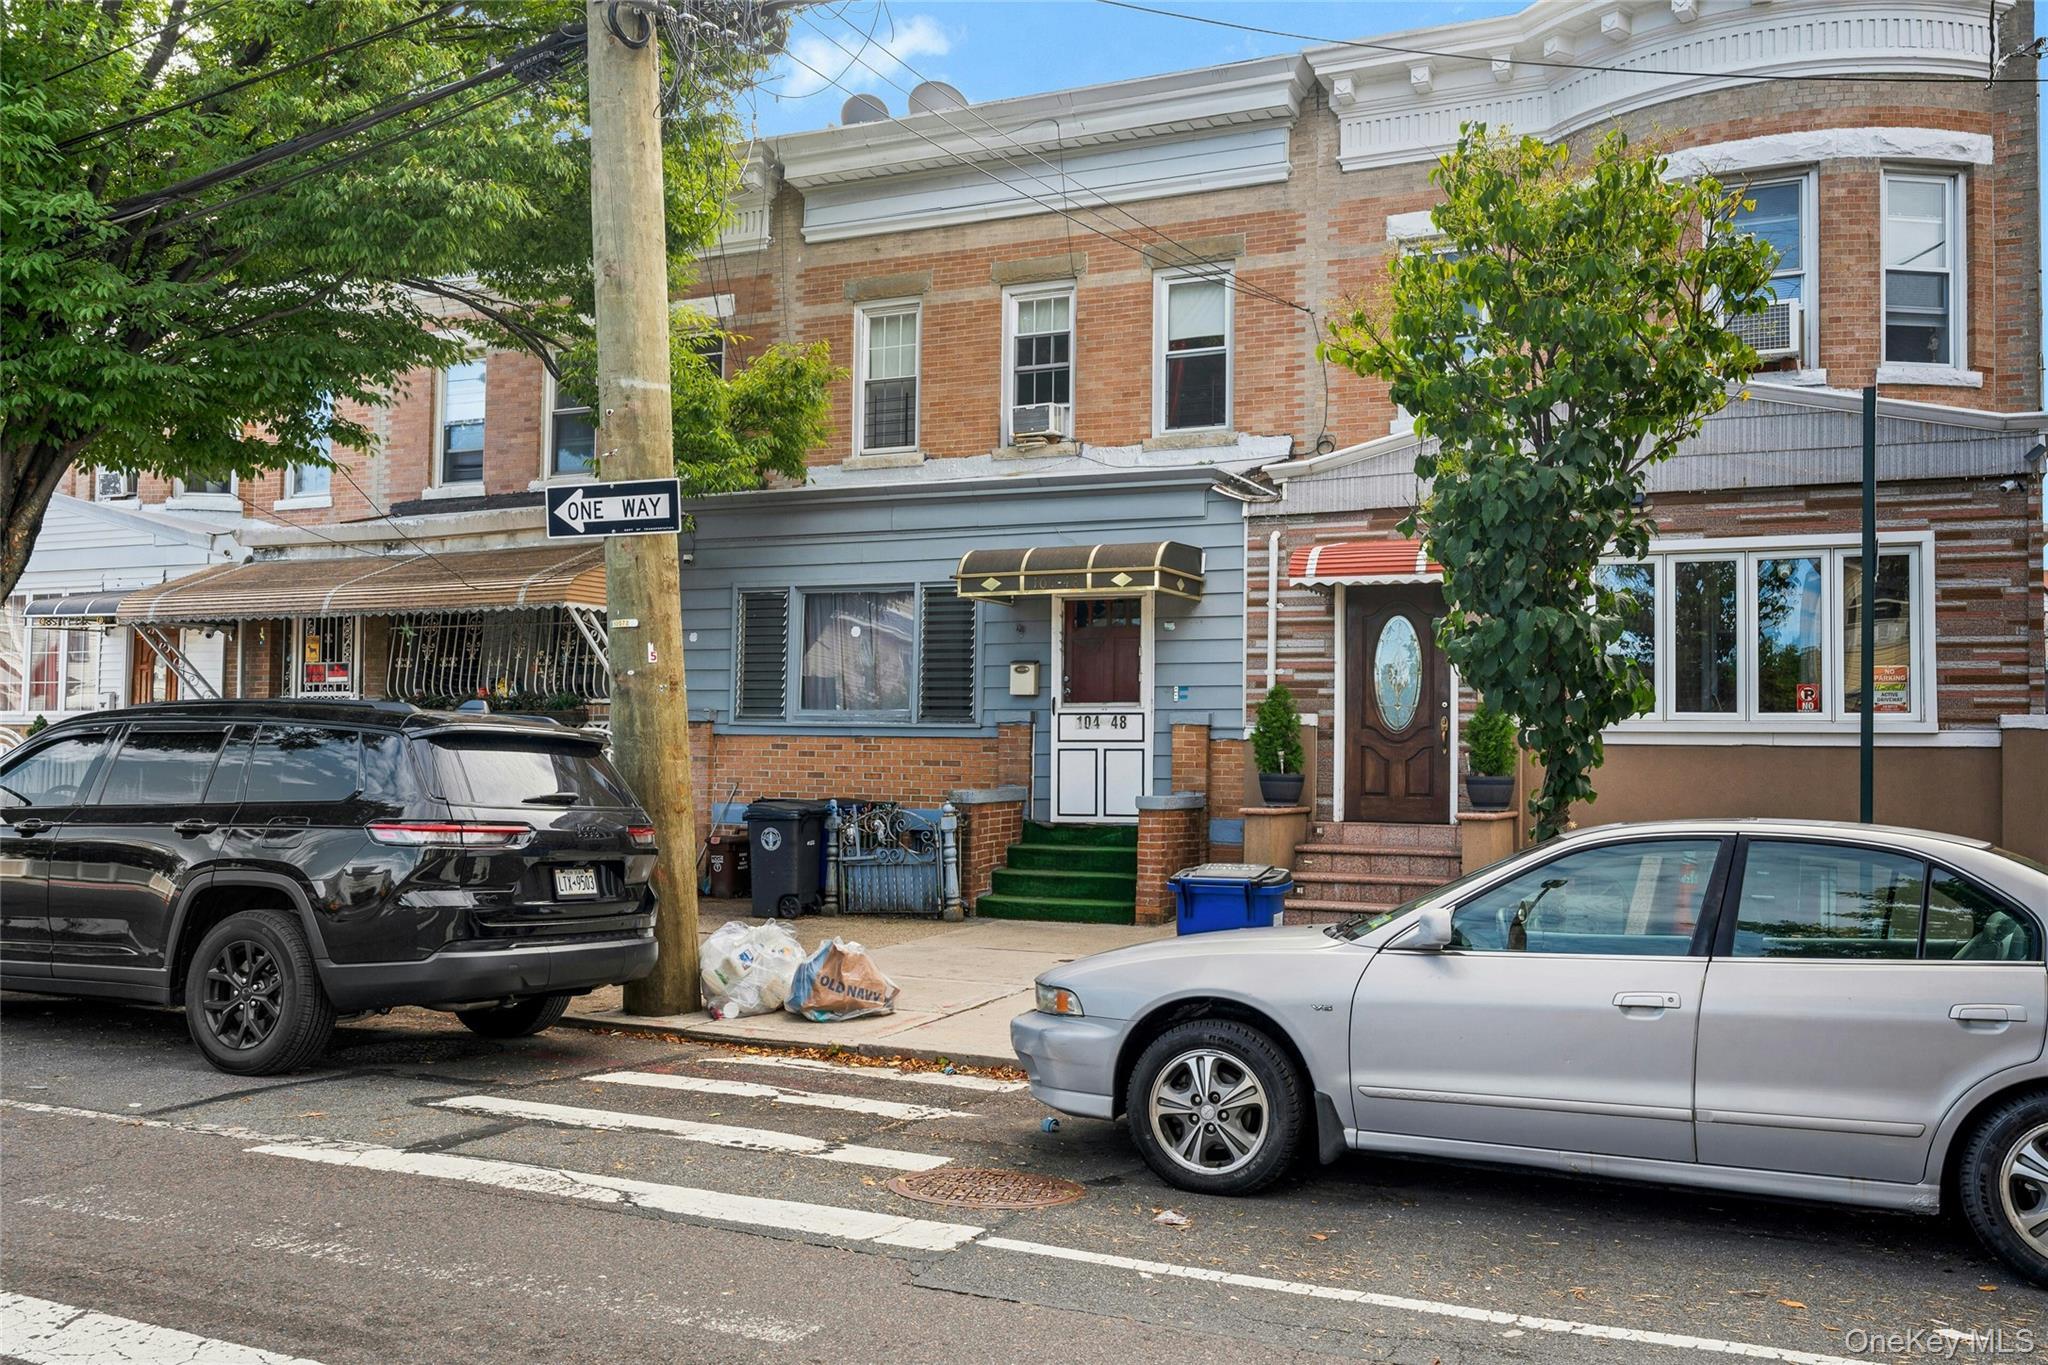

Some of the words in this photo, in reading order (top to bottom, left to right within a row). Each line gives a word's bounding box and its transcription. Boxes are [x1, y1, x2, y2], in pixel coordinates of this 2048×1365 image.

[568, 501, 603, 520] ONE
[622, 497, 661, 518] WAY
[651, 651, 657, 660] 5
[1802, 702, 1814, 710] NO
[1076, 715, 1100, 729] 104
[1110, 715, 1127, 729] 48
[820, 976, 846, 993] OLD
[847, 985, 882, 1002] NAVY
